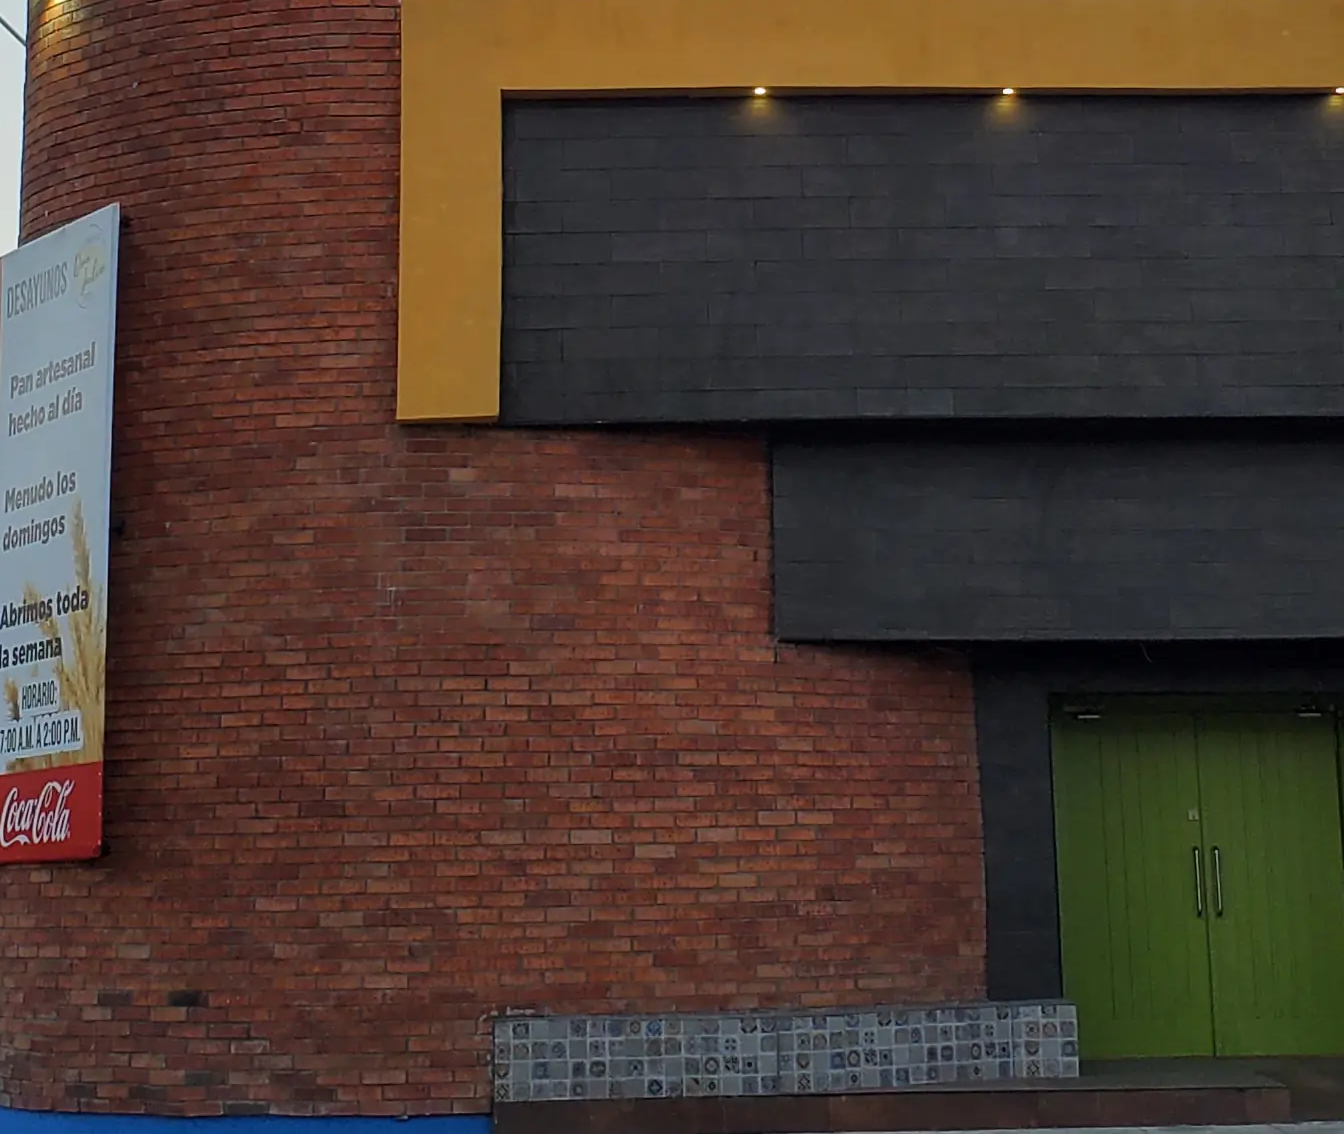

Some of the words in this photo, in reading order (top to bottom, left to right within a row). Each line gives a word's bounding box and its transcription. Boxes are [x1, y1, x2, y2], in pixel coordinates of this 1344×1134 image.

[6, 260, 68, 319] DESAYUNOS
[10, 373, 33, 400] Pan
[35, 341, 96, 390] artesanal
[7, 405, 45, 438] hecho
[47, 398, 60, 427] al
[62, 386, 83, 417] día
[4, 476, 54, 514] Menudo
[57, 470, 77, 497] los
[2, 514, 66, 552] domingos
[0, 596, 54, 631] Abrimos
[56, 585, 90, 617] toda
[11, 635, 63, 667] semana
[21, 679, 58, 711] HORARIO:
[0, 727, 16, 755] 7:00
[17, 724, 34, 751] A.M.
[35, 722, 42, 749] A
[43, 719, 62, 747] 2:00
[63, 716, 81, 745] P.M.
